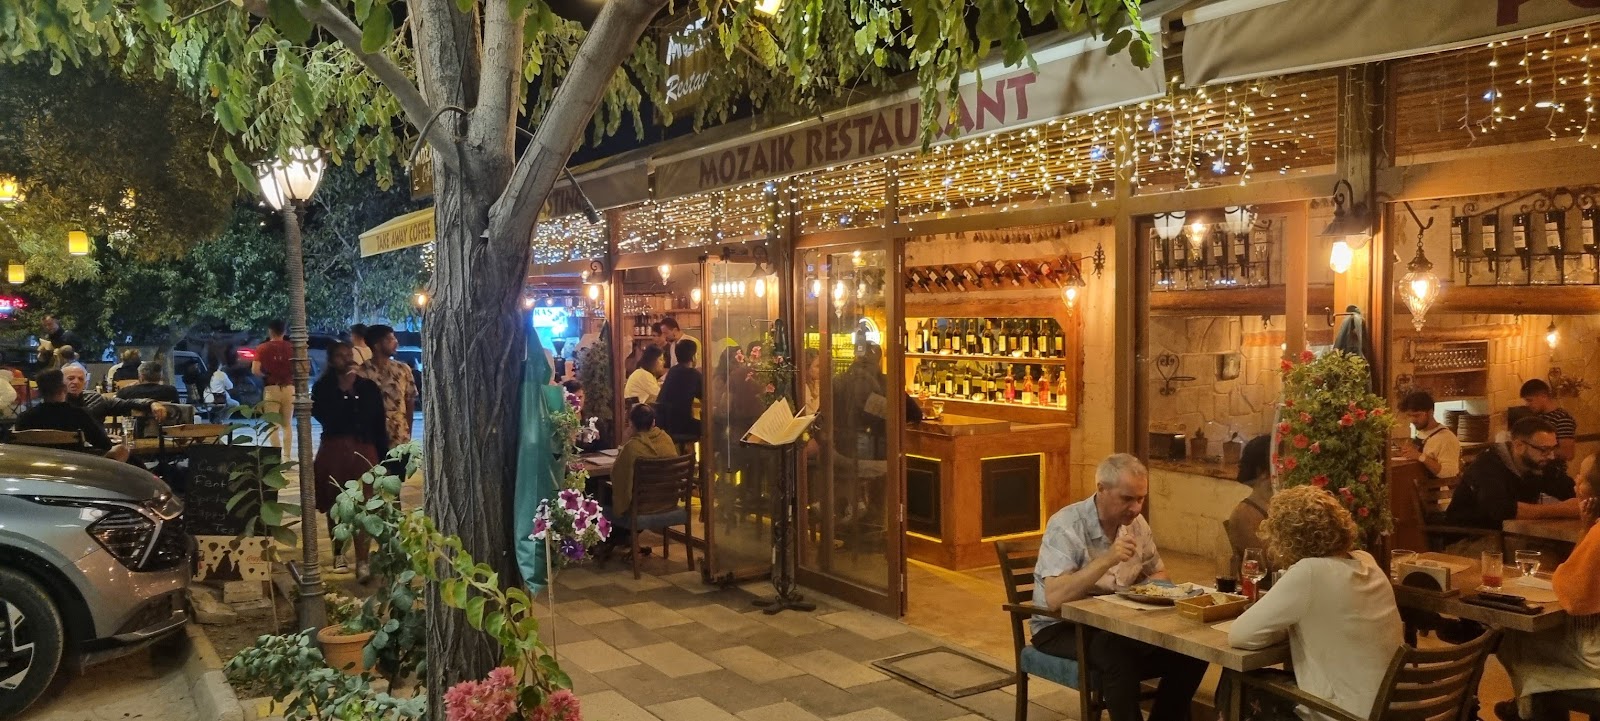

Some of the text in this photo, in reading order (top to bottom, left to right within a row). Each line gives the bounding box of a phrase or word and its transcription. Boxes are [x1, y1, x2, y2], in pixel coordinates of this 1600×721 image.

[698, 133, 796, 189] MOZAIK
[376, 220, 431, 252] TAKE AWAY COFFEE
